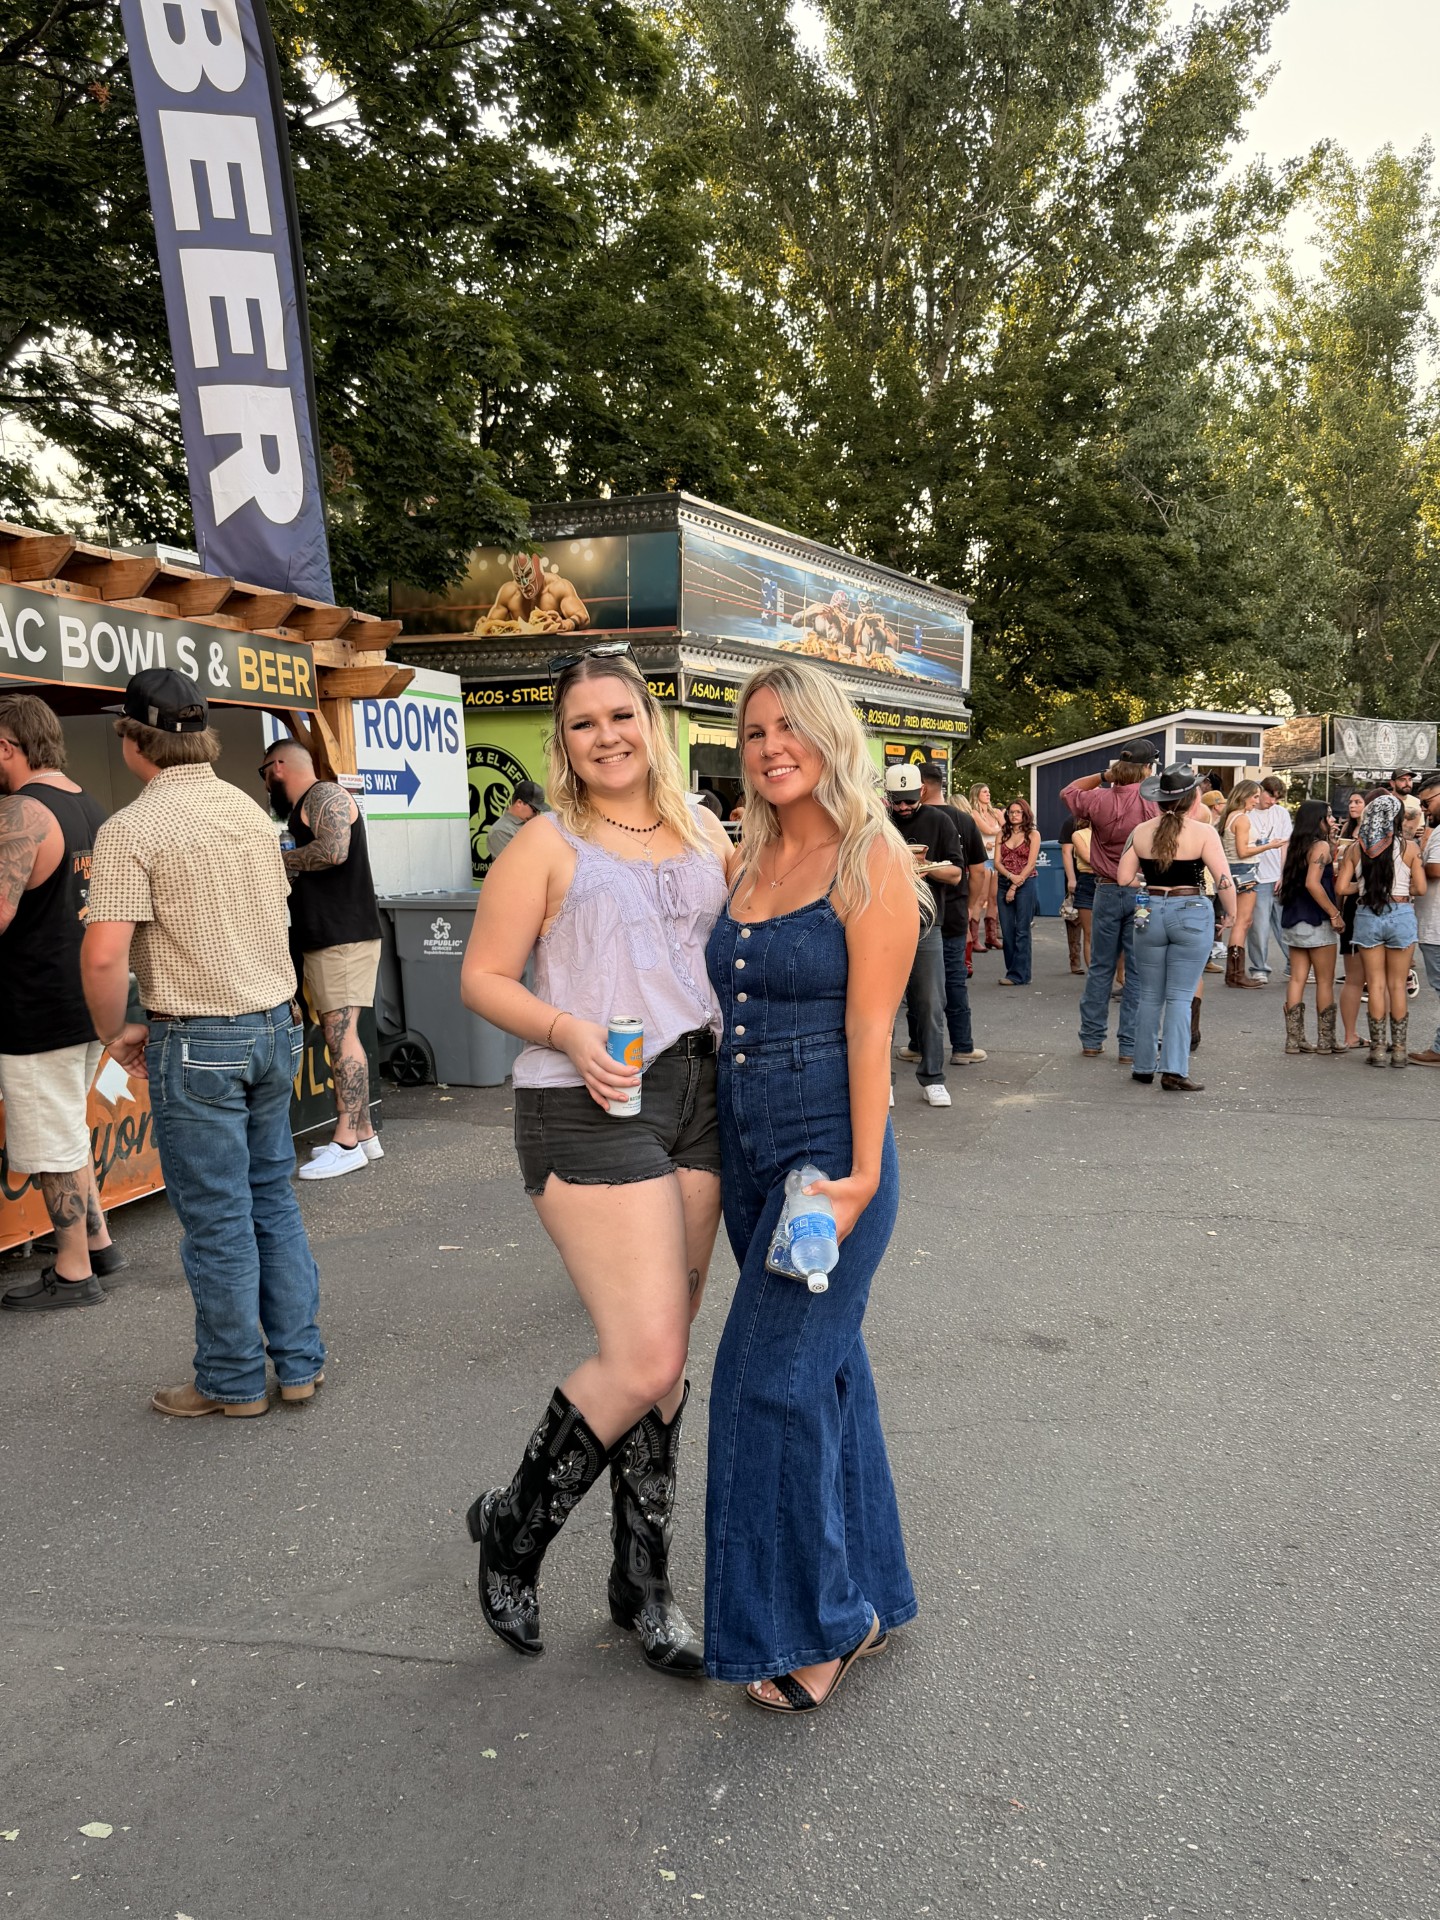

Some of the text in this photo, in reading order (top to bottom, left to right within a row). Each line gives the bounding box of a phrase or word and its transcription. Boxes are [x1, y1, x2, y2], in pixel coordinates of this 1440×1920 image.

[140, 0, 303, 526] BEER
[208, 641, 231, 688] &
[238, 646, 312, 698] BEER
[461, 690, 504, 705] ACOS
[691, 682, 720, 700] ASADA
[353, 699, 459, 754] ROOMS
[475, 751, 484, 763] &
[486, 752, 500, 767] EL
[374, 774, 397, 791] WAY
[423, 939, 460, 947] REPUBLIC
